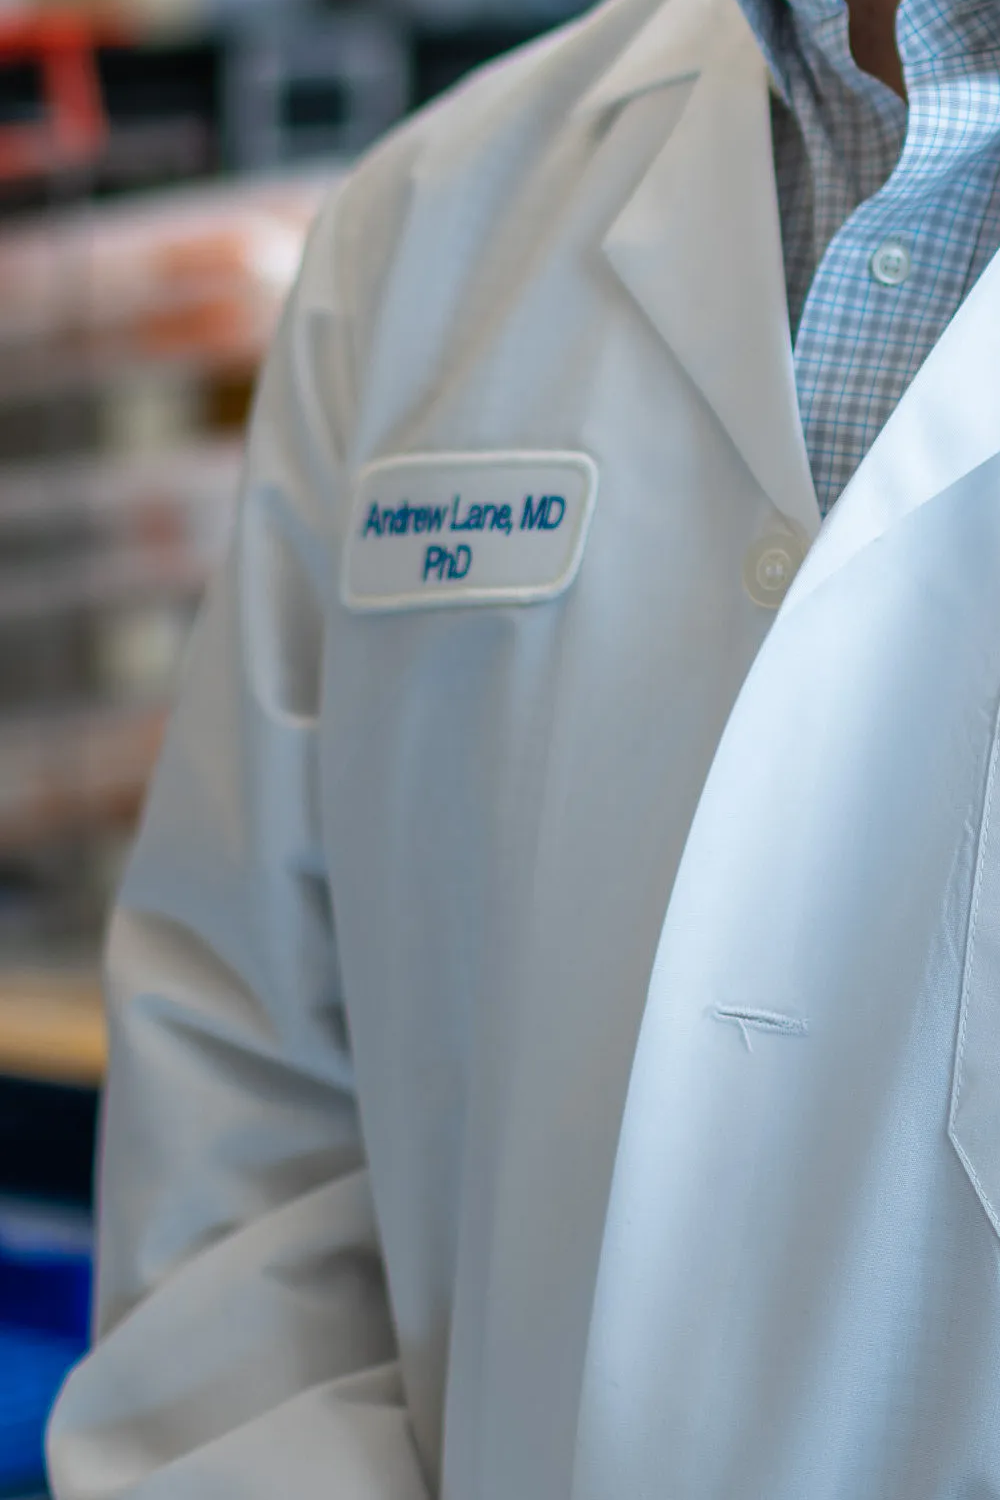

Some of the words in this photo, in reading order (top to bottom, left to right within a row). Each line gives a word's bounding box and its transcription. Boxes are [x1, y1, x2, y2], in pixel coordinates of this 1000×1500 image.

[362, 499, 449, 538] Andrew
[450, 494, 513, 536] Lane,
[519, 495, 567, 531] MD
[421, 544, 473, 582] PhD
